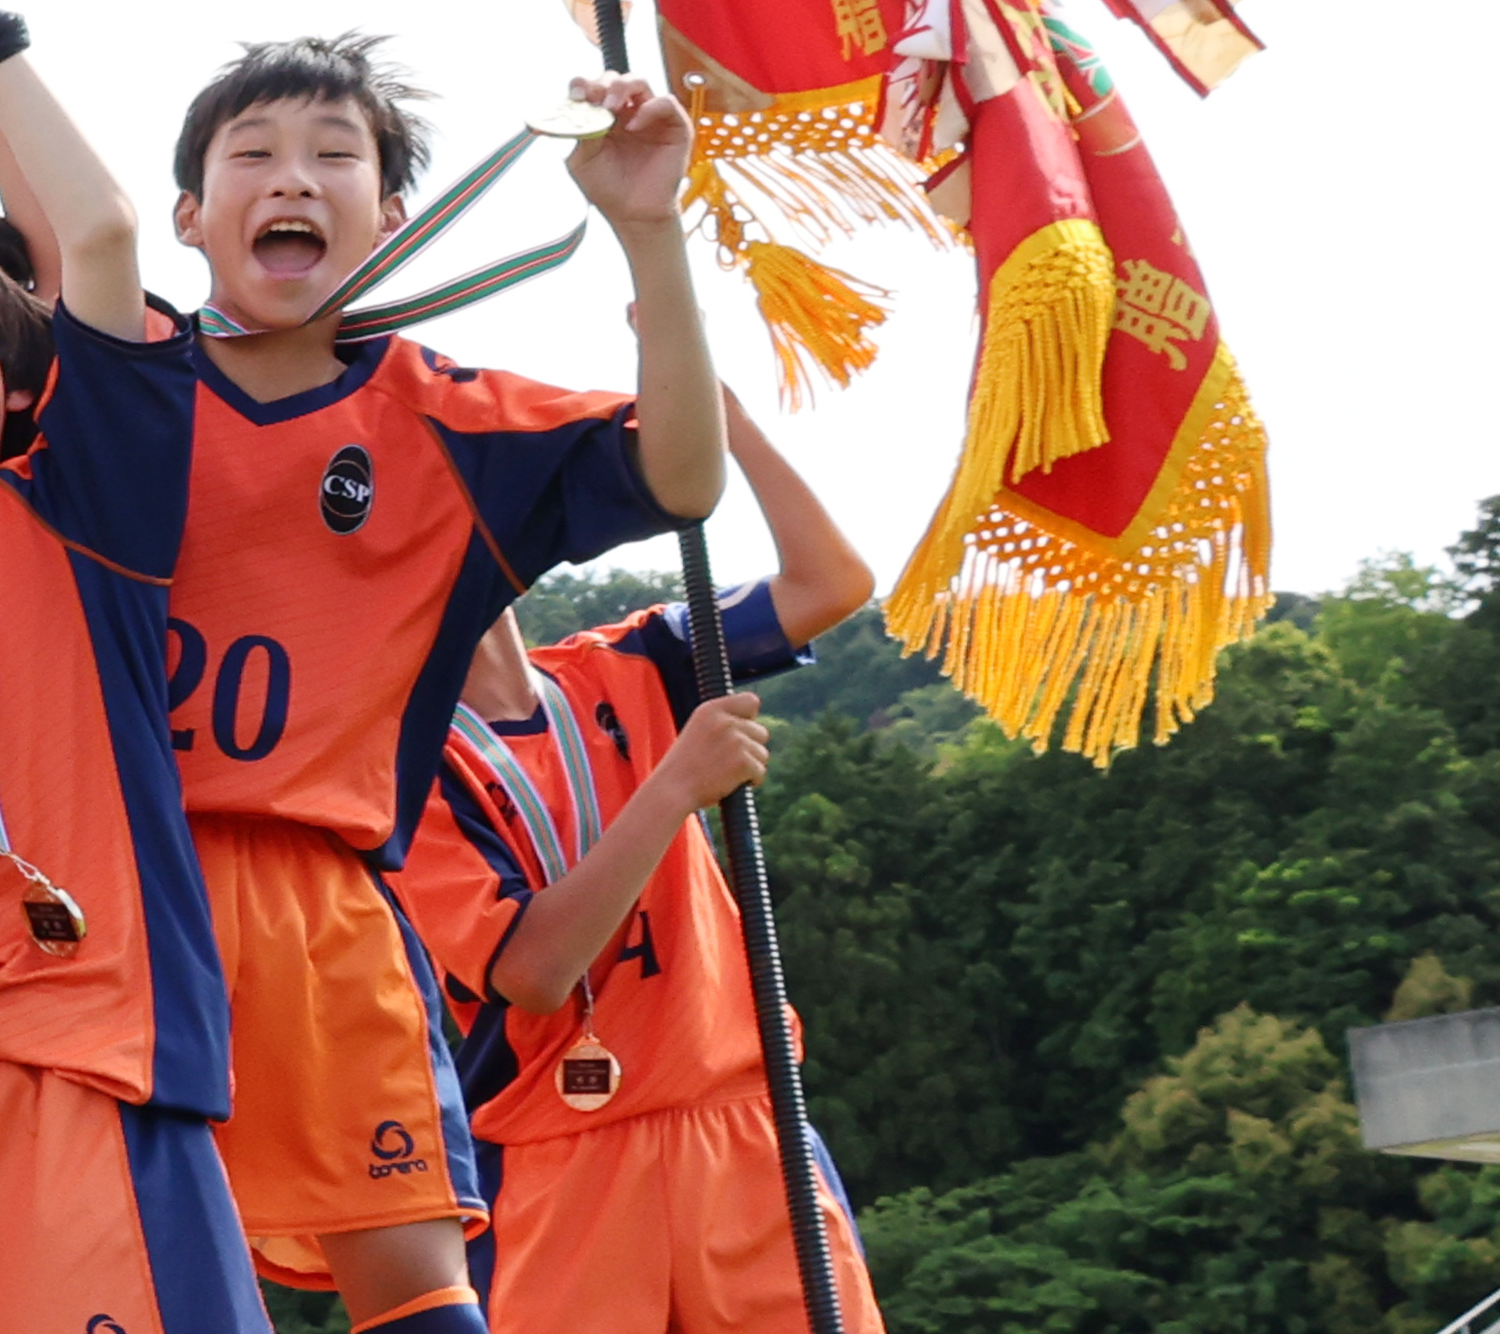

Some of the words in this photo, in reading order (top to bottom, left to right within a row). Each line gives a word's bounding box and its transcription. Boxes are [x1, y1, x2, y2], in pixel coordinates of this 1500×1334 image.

[1115, 258, 1208, 370] 贈
[322, 473, 373, 504] CSP
[168, 618, 291, 762] 20
